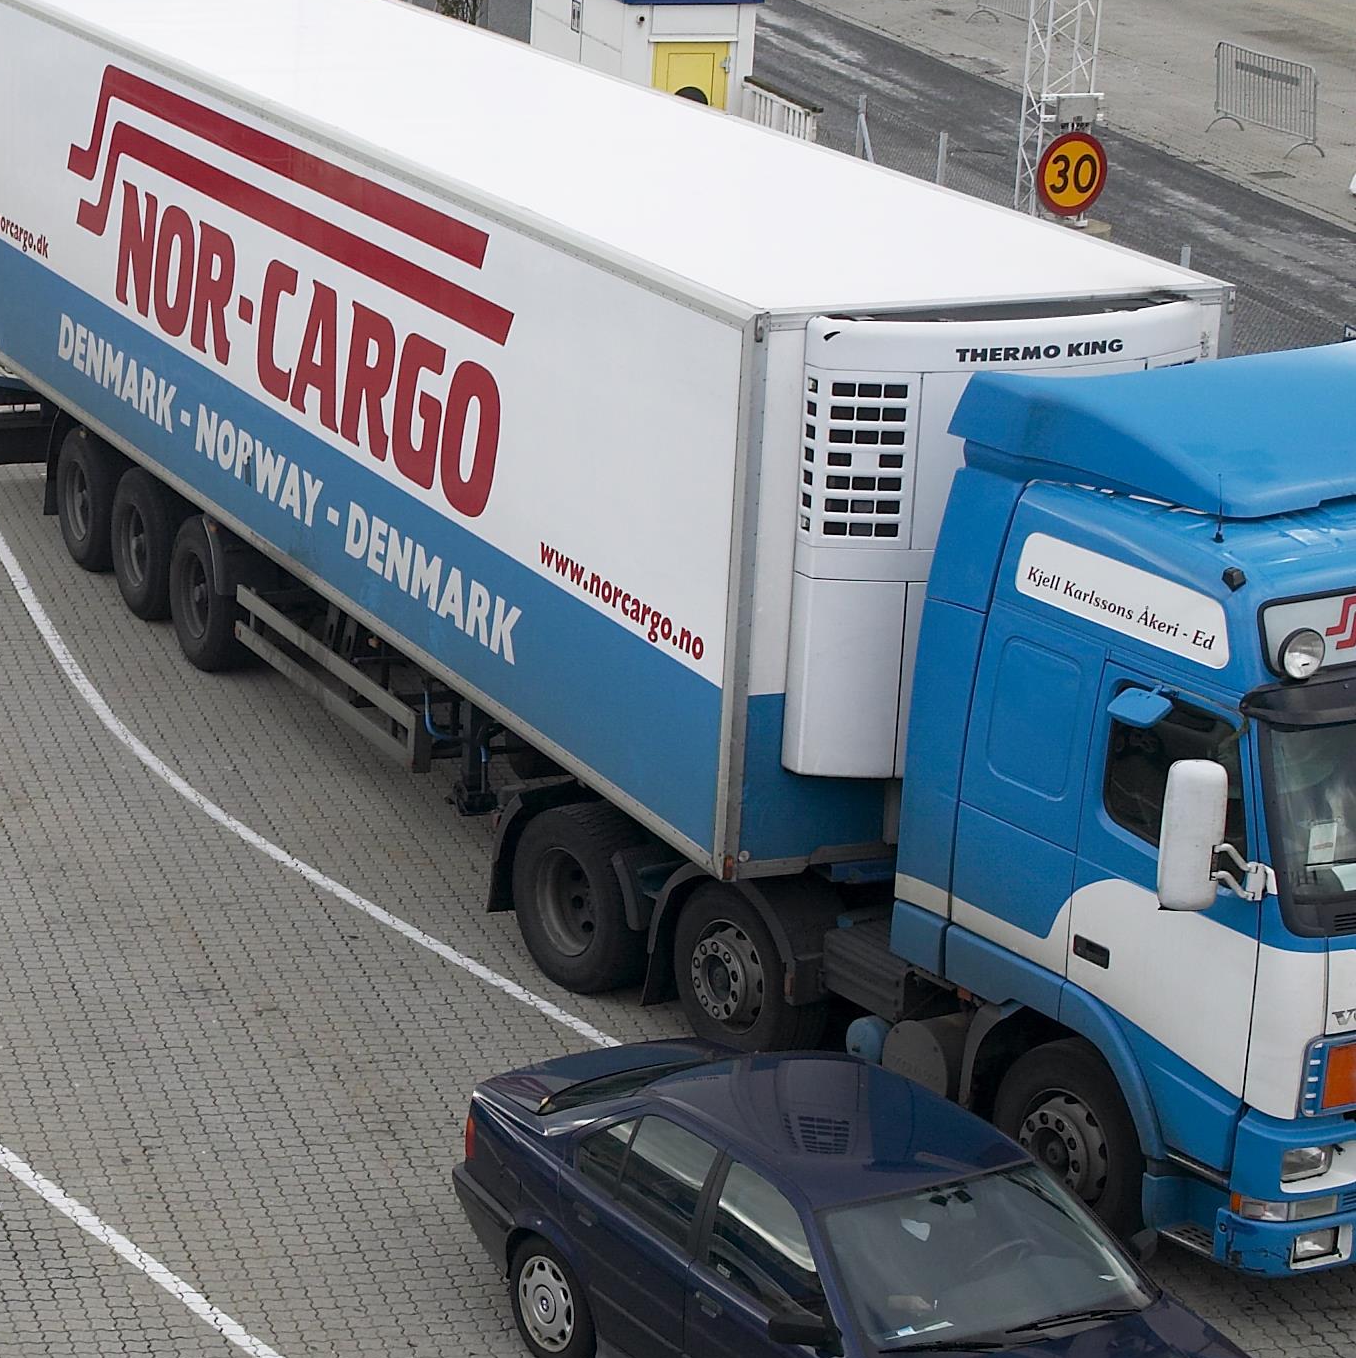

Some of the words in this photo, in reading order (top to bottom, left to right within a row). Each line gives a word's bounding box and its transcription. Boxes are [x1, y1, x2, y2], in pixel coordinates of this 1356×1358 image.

[1049, 154, 1097, 194] 30
[115, 178, 501, 519] NOR-CARGO
[955, 344, 1061, 363] THERMO
[1067, 338, 1124, 357] KING
[57, 312, 177, 434] DENMARK
[194, 403, 324, 528] NORWAY
[344, 500, 523, 666] DENMARK
[540, 541, 705, 661] www.norcargo.no
[1026, 565, 1061, 591] Kjell
[1063, 580, 1135, 621] Karlssons
[1136, 605, 1180, 638] Åkeri
[1191, 629, 1216, 651] Ed
